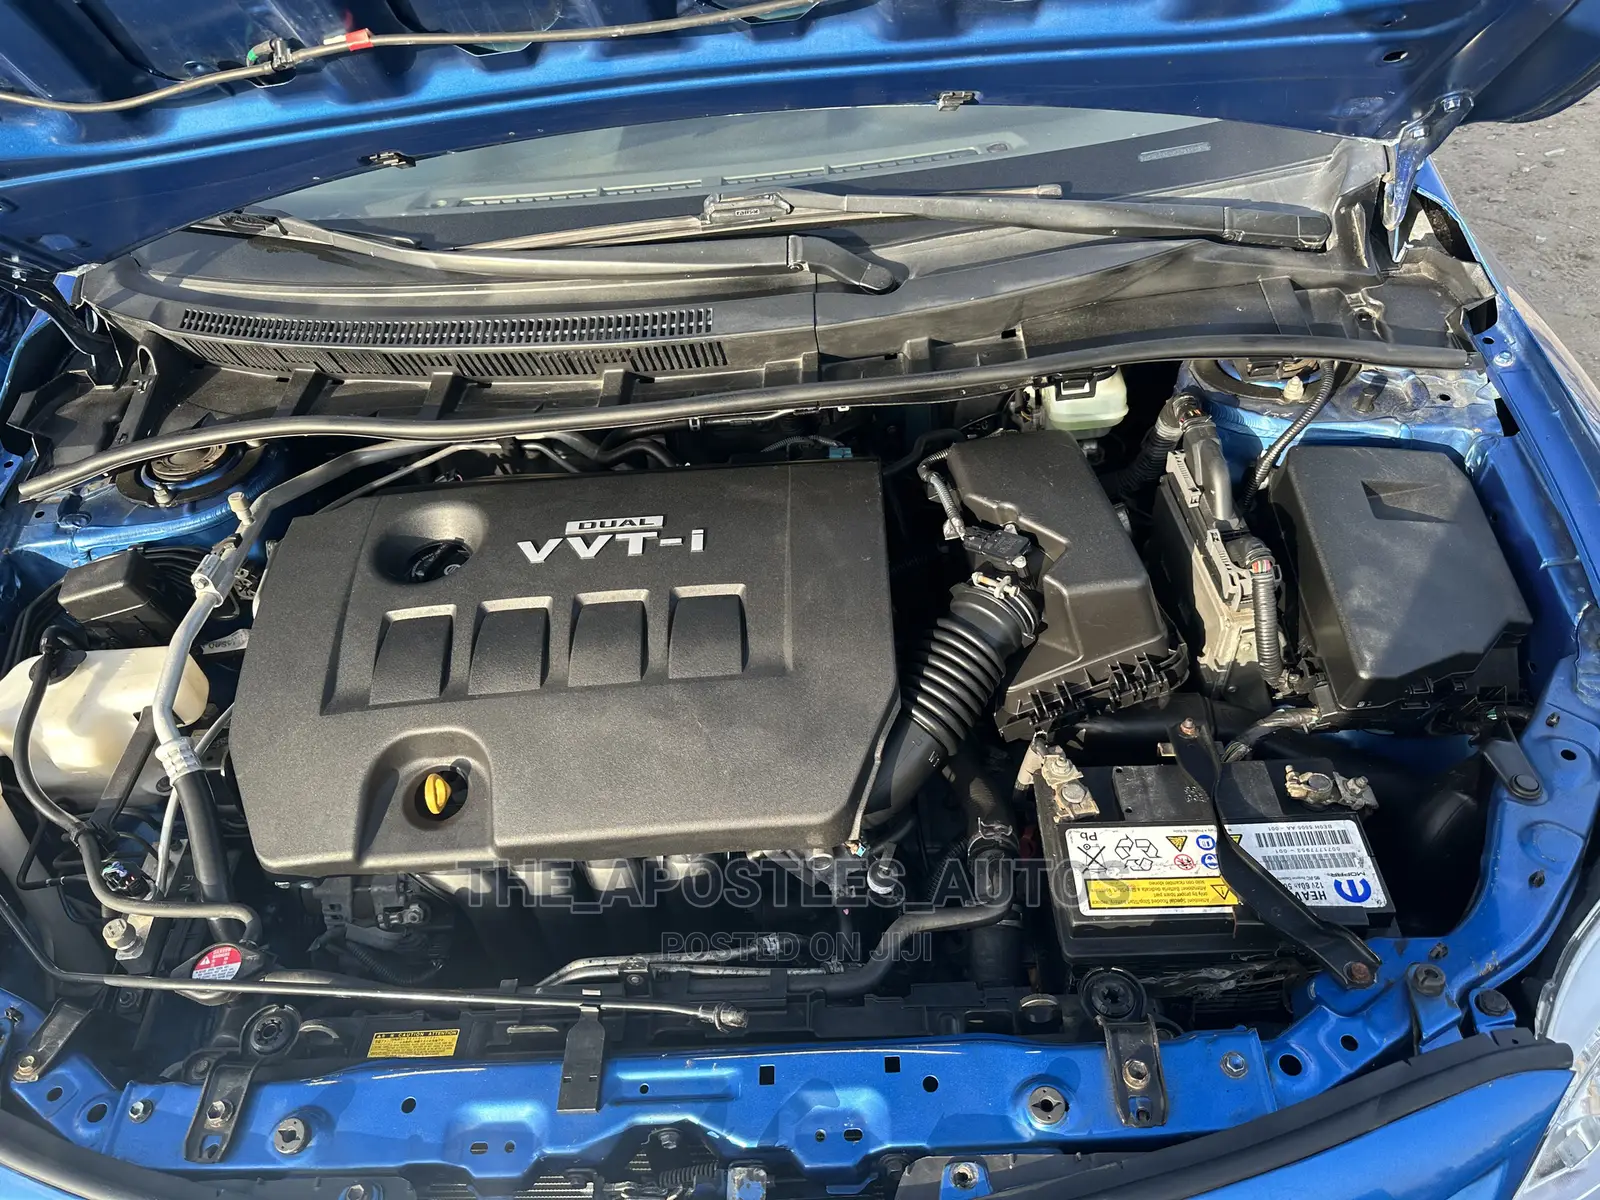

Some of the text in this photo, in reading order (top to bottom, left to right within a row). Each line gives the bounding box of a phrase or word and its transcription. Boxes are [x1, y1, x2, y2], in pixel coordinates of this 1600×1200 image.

[577, 517, 656, 530] DUAL
[516, 528, 706, 563] VVT-i
[1079, 831, 1098, 841] Pb
